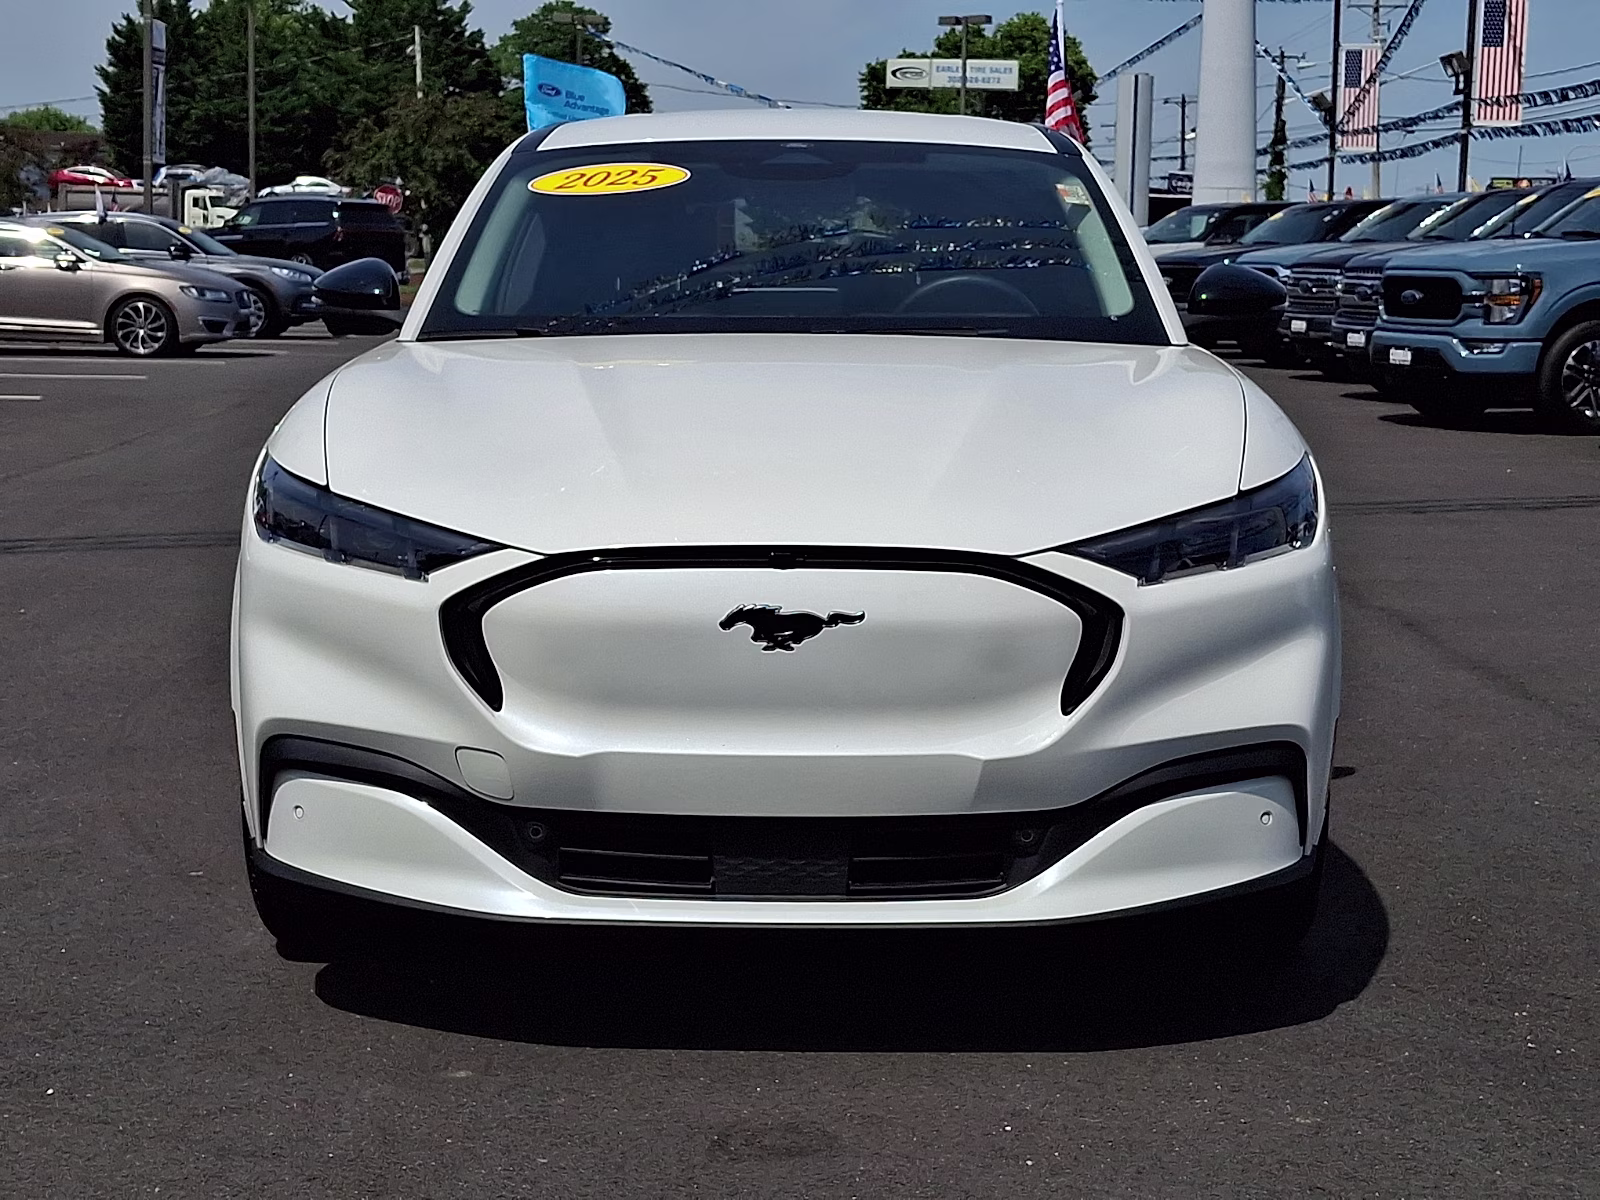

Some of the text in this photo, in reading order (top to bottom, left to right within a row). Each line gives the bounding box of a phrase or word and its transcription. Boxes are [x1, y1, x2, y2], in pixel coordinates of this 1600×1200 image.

[989, 67, 1013, 75] SALES
[565, 90, 585, 102] Blue
[564, 100, 610, 116] Advantage
[555, 169, 665, 190] 2025
[376, 191, 400, 207] STOP
